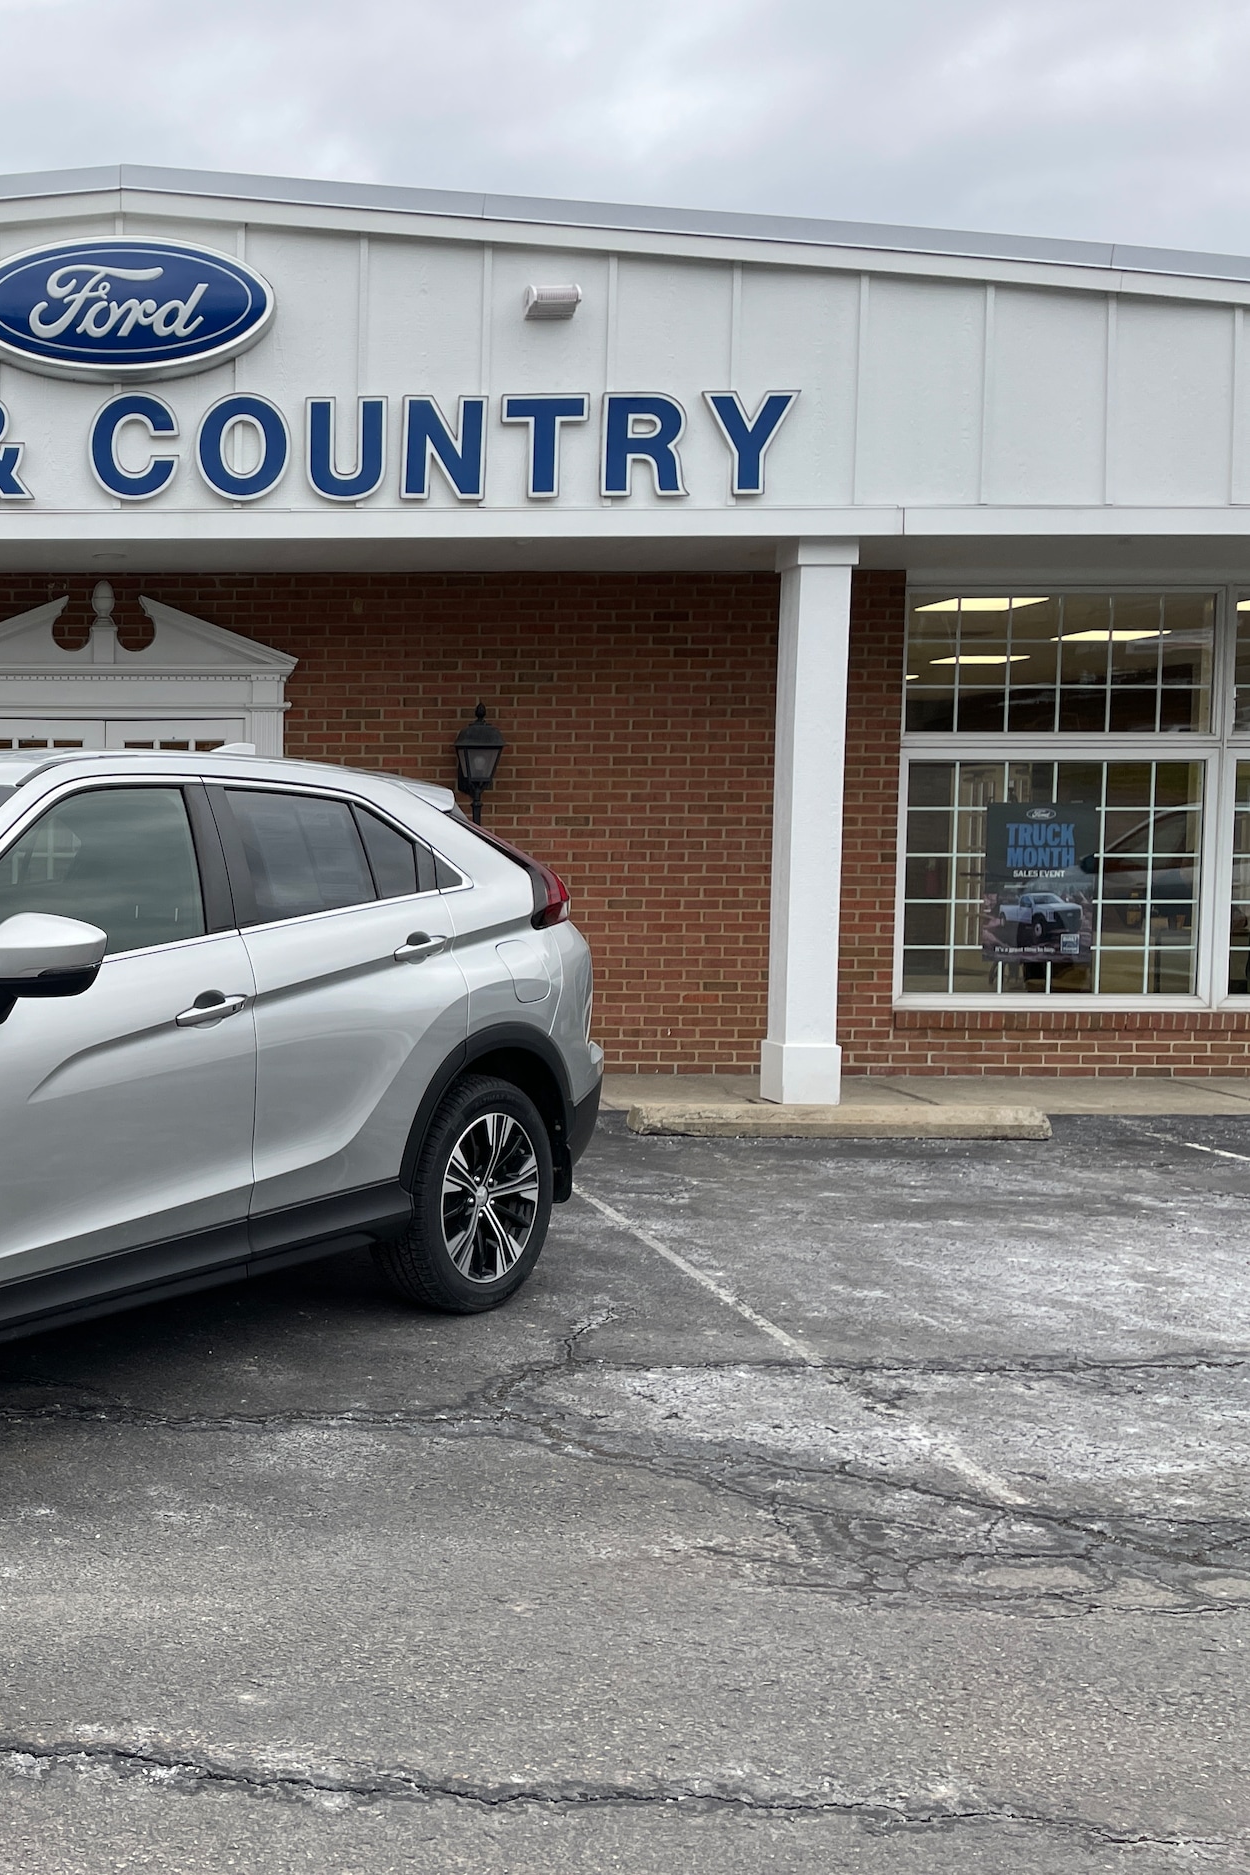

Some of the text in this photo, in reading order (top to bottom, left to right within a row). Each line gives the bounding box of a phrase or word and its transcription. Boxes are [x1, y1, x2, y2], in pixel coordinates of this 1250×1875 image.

[29, 264, 209, 338] Ford
[87, 389, 801, 502] COUNTRY
[1005, 823, 1075, 846] TRUCK
[1006, 847, 1075, 868] MONTH
[1013, 869, 1066, 878] SALES EVENT
